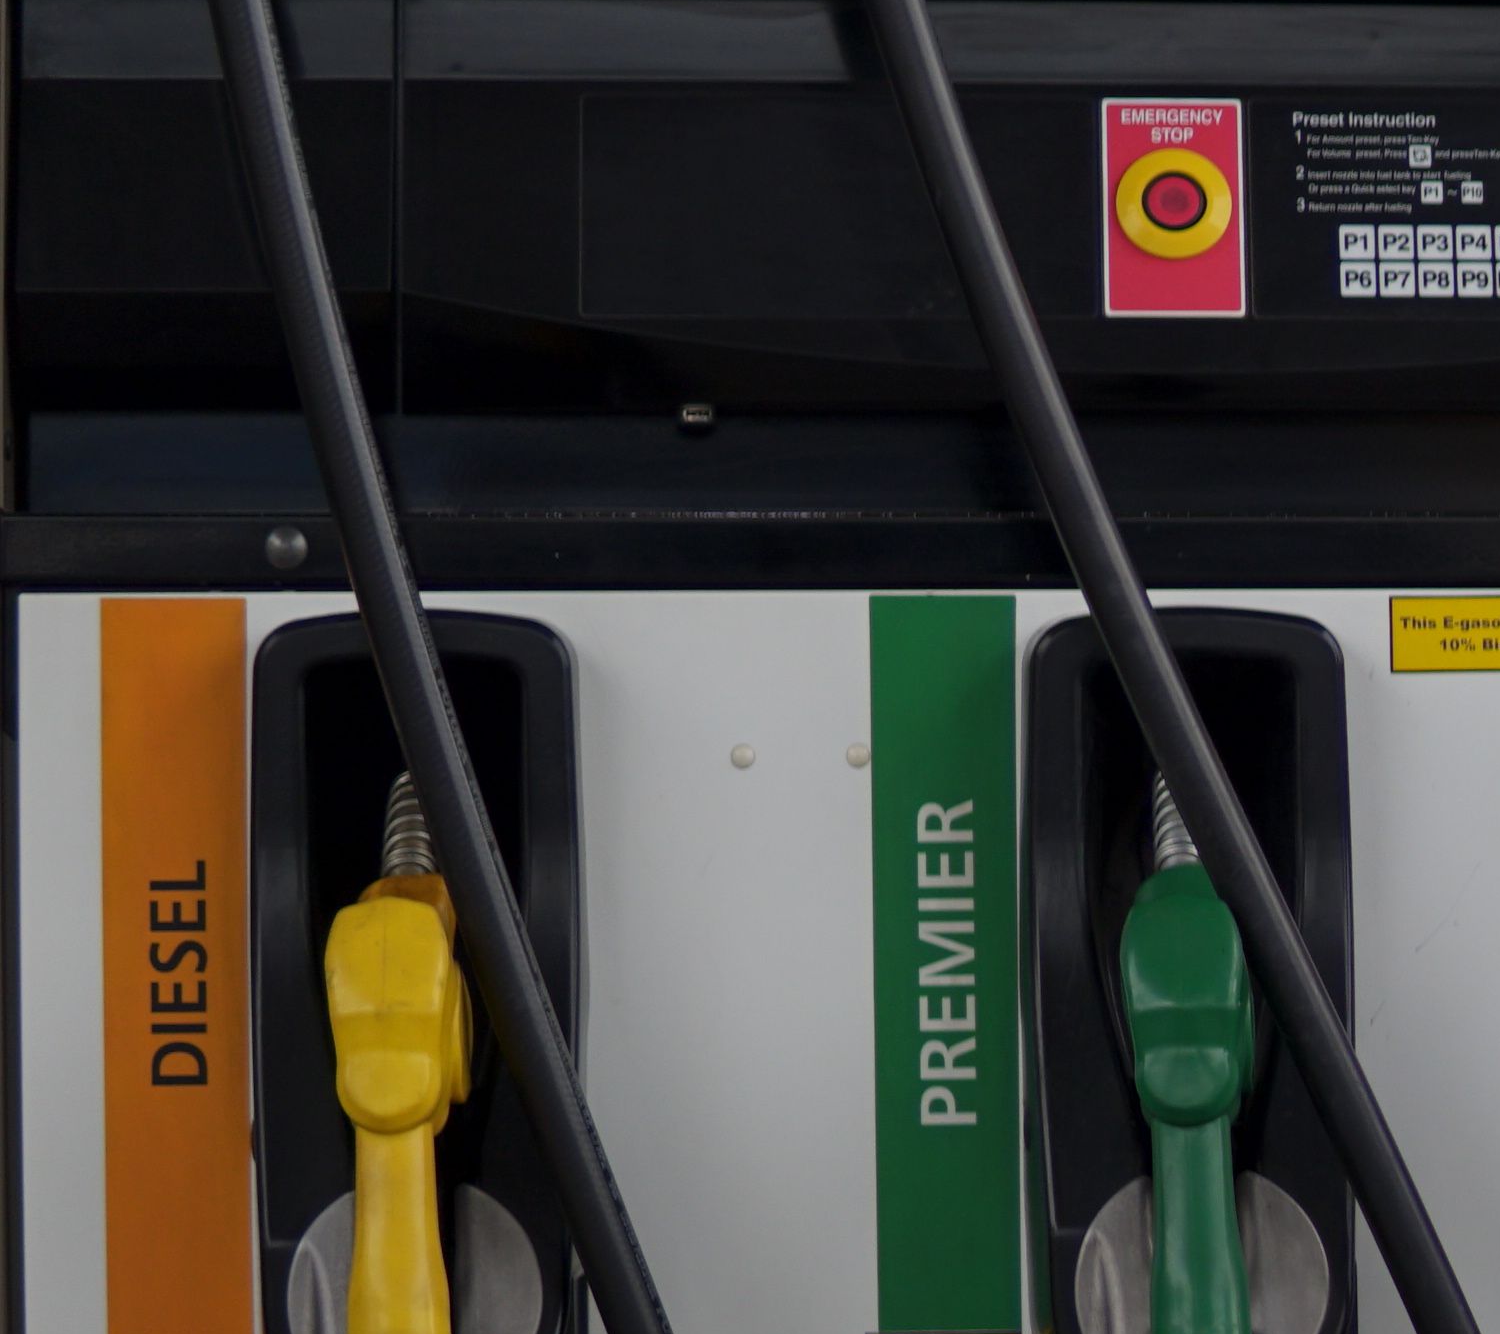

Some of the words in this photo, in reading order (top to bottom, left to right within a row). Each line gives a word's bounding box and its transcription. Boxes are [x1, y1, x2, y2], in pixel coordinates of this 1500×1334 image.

[1121, 108, 1223, 125] EMERGENCY
[1292, 112, 1344, 128] Preset
[1349, 112, 1436, 128] Instruction
[1151, 127, 1193, 143] STOP
[1296, 165, 1304, 180] 2
[1424, 187, 1439, 198] P1
[1462, 186, 1482, 198] P10
[1297, 197, 1305, 212] 3
[1344, 234, 1368, 252] P1
[1382, 234, 1410, 252] P2
[1421, 234, 1449, 252] P3
[1461, 234, 1488, 252] P4
[1344, 270, 1372, 288] P6
[1383, 270, 1411, 288] P7
[1422, 270, 1450, 288] P8
[1462, 270, 1489, 288] P9
[1401, 617, 1436, 630] This
[1439, 639, 1476, 652] 10%
[917, 798, 978, 1127] PREMIER
[149, 860, 209, 1087] DIESEL
